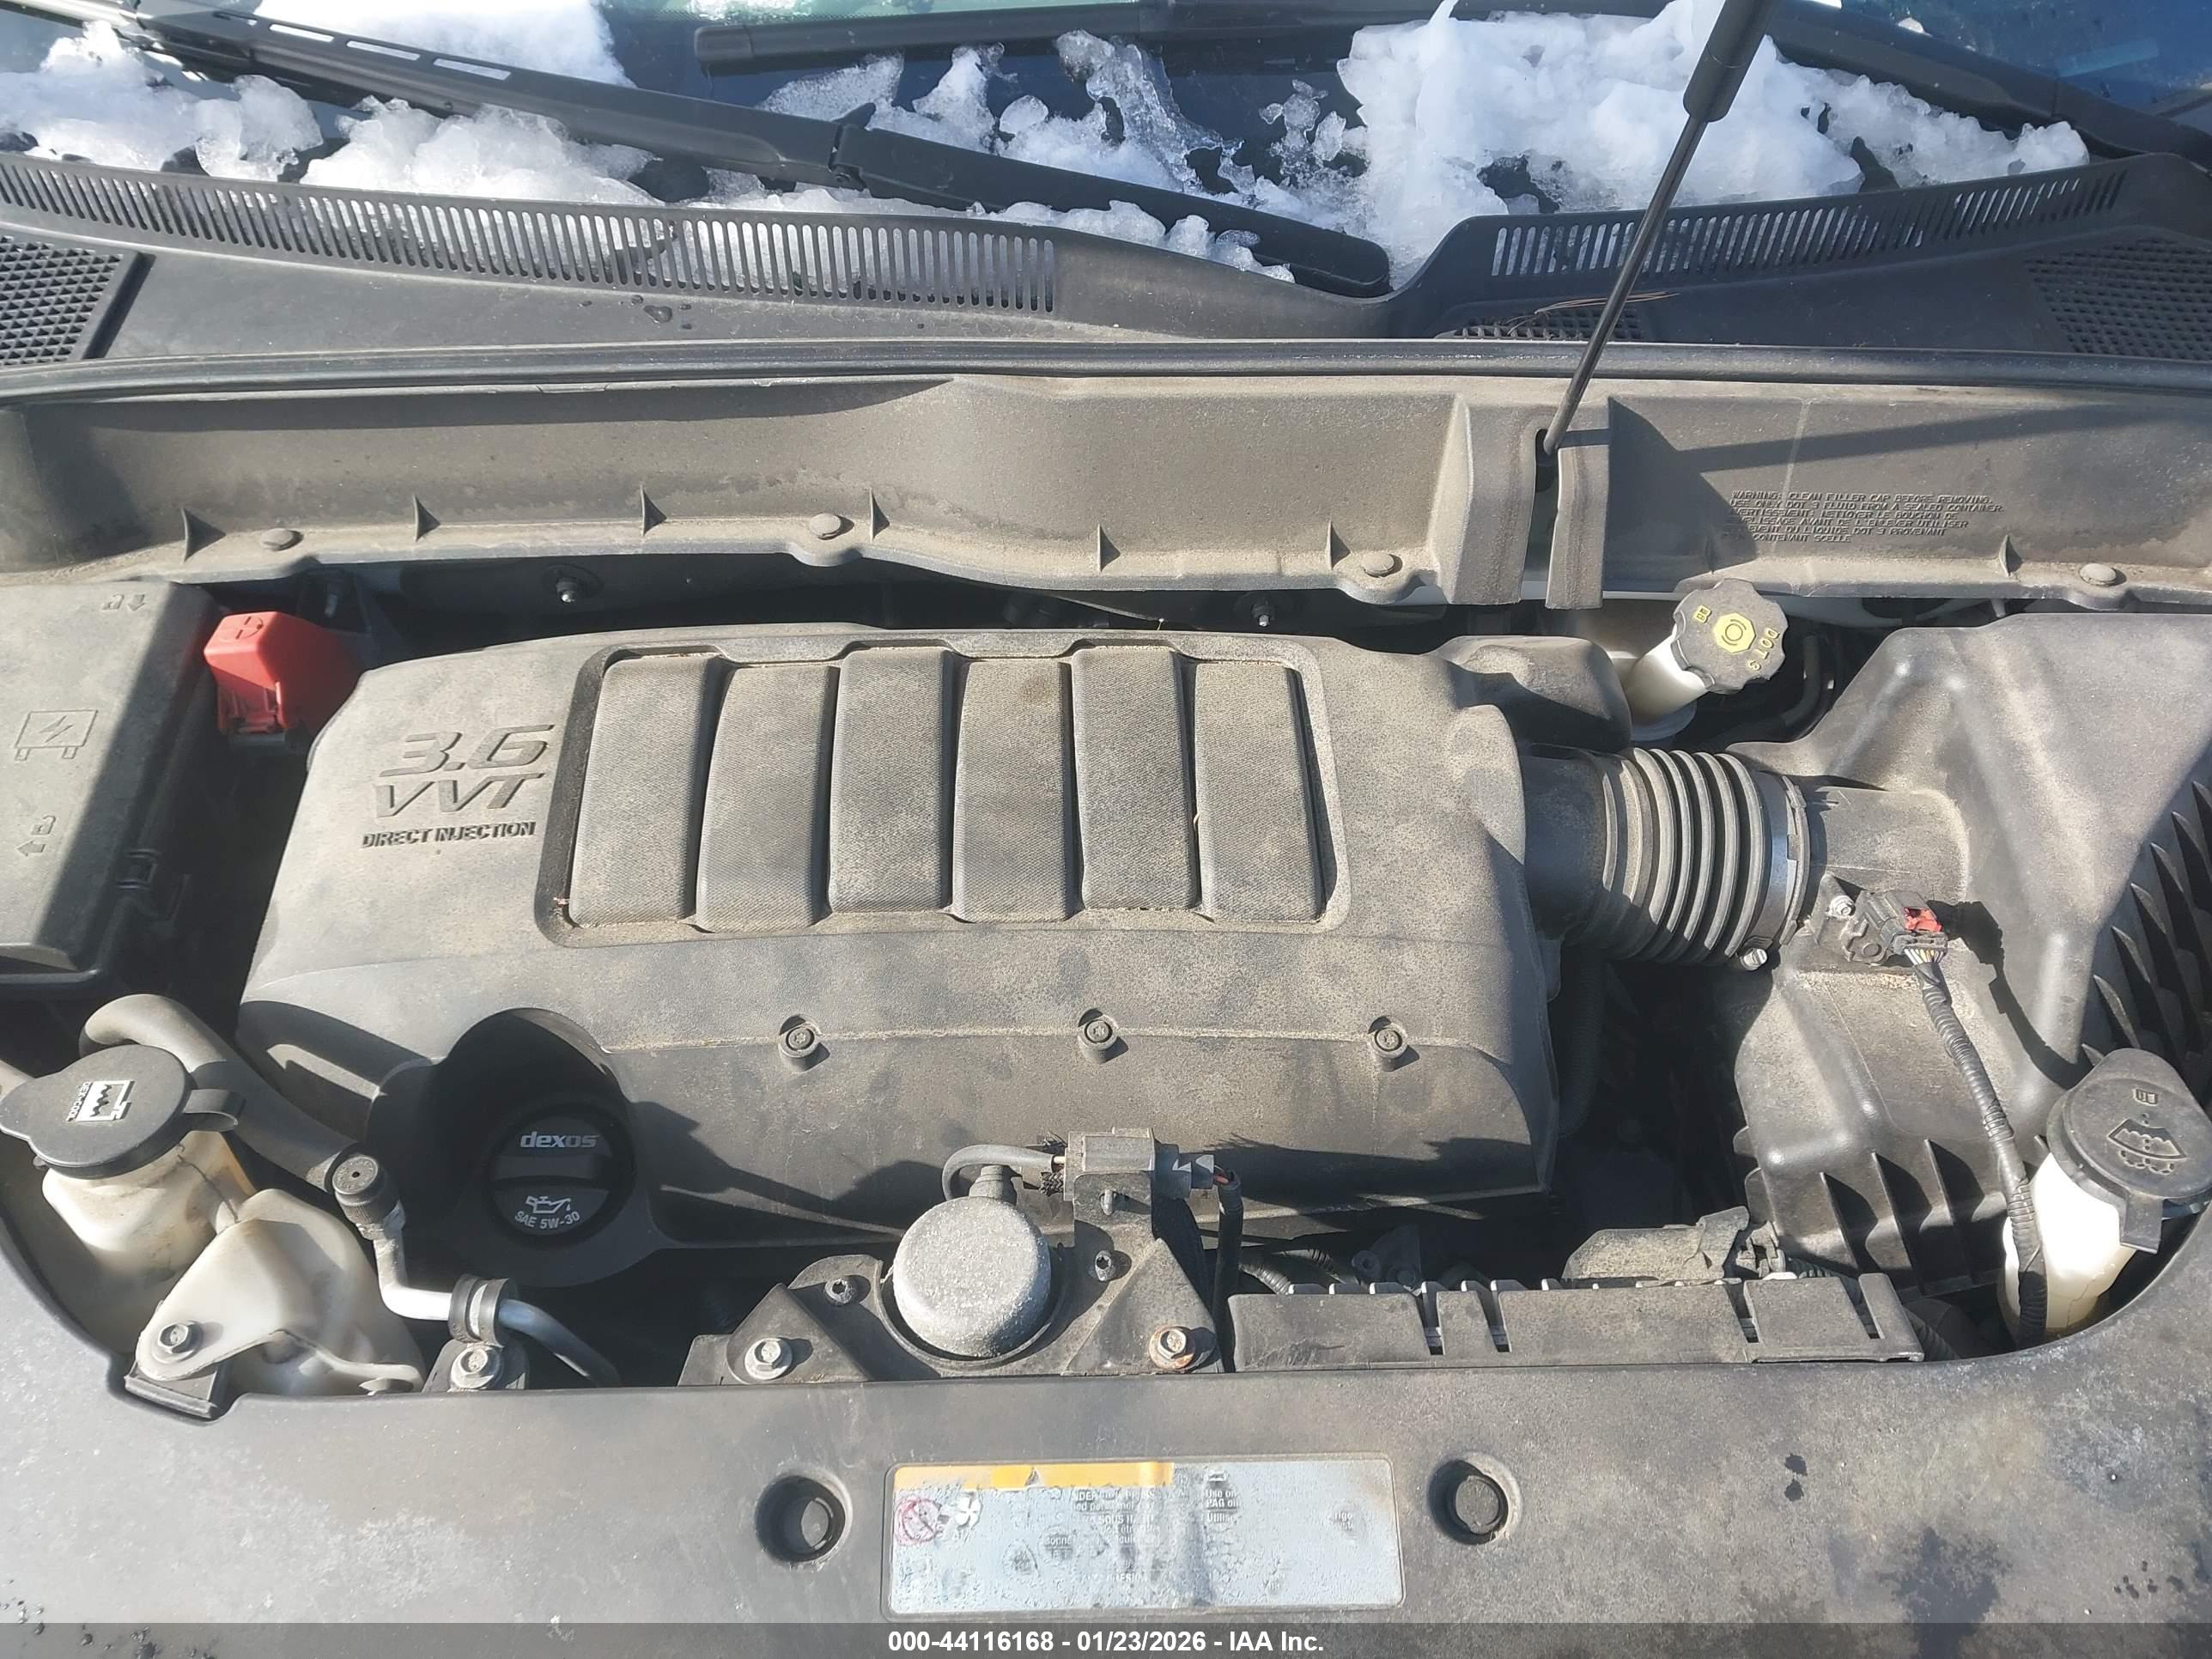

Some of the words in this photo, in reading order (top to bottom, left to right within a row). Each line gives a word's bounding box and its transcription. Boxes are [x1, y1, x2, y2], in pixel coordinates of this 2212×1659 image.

[1731, 490, 1782, 499] WARNING:
[1788, 491, 1822, 501] CLEAN
[1826, 492, 1866, 501] FILLER
[1869, 493, 1890, 502] CAP
[1893, 494, 1933, 502] BEFORE
[1729, 499, 1750, 507] USE
[1754, 500, 1782, 508] ONLY
[1786, 500, 1806, 509] DOT
[1823, 501, 1856, 510] FLUID
[1860, 501, 1887, 510] FROM
[1890, 502, 1899, 511] A
[1903, 502, 1942, 512] SEALED
[1837, 518, 1852, 526] DE
[1875, 510, 1891, 519] LE
[1894, 510, 1941, 520] BOUCHON
[1943, 511, 1958, 520] DE
[1785, 525, 1800, 533] DU
[1852, 526, 1873, 536] DOT
[1889, 526, 1946, 537] PROVENANT
[1753, 627, 1780, 659] DOT
[379, 724, 556, 777] 3.6
[375, 773, 545, 818] VVT
[362, 828, 433, 848] DIRECT
[434, 821, 537, 843] INJECTION
[520, 1131, 601, 1148] dexos
[514, 1211, 537, 1228] SAE
[539, 1211, 580, 1229] 5W-30
